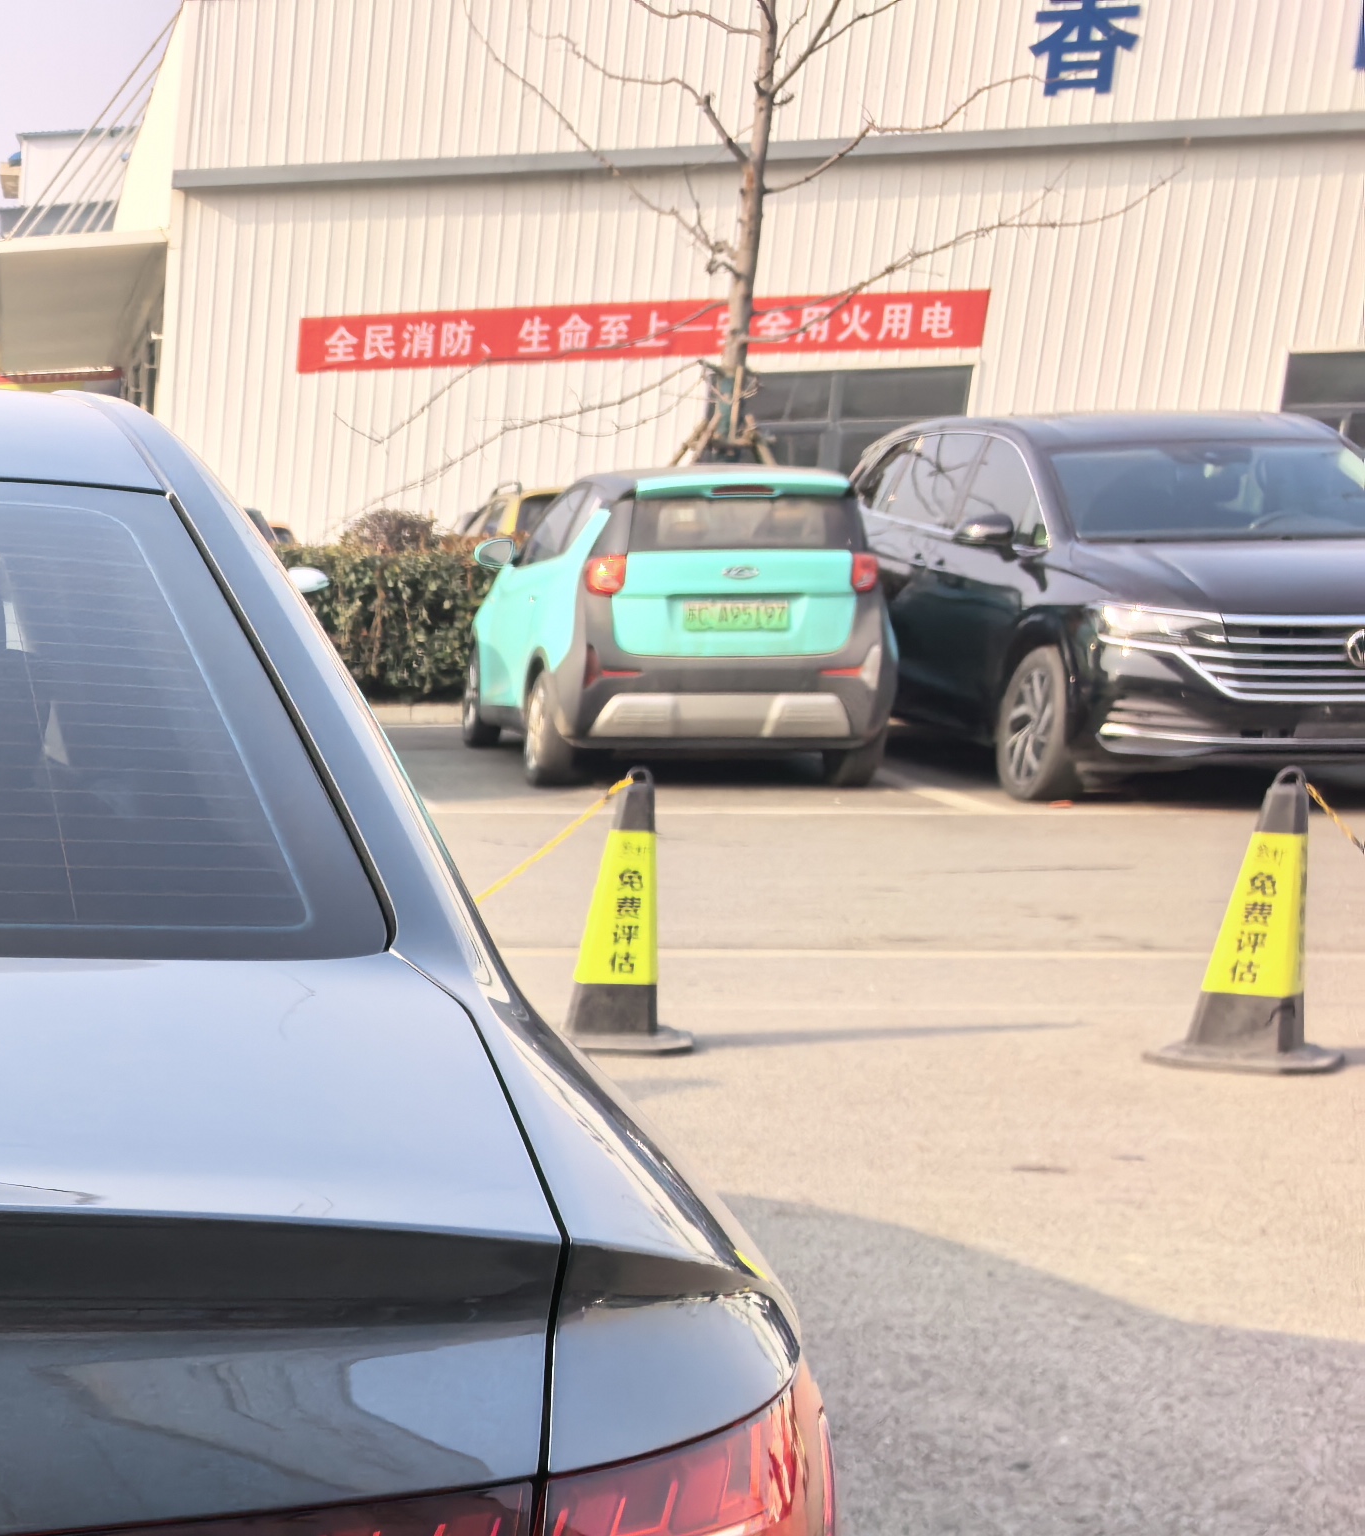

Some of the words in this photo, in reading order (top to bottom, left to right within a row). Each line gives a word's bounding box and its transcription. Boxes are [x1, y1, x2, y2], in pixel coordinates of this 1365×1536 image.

[610, 867, 644, 974] 免费评估
[1230, 871, 1278, 984] 免费评估
